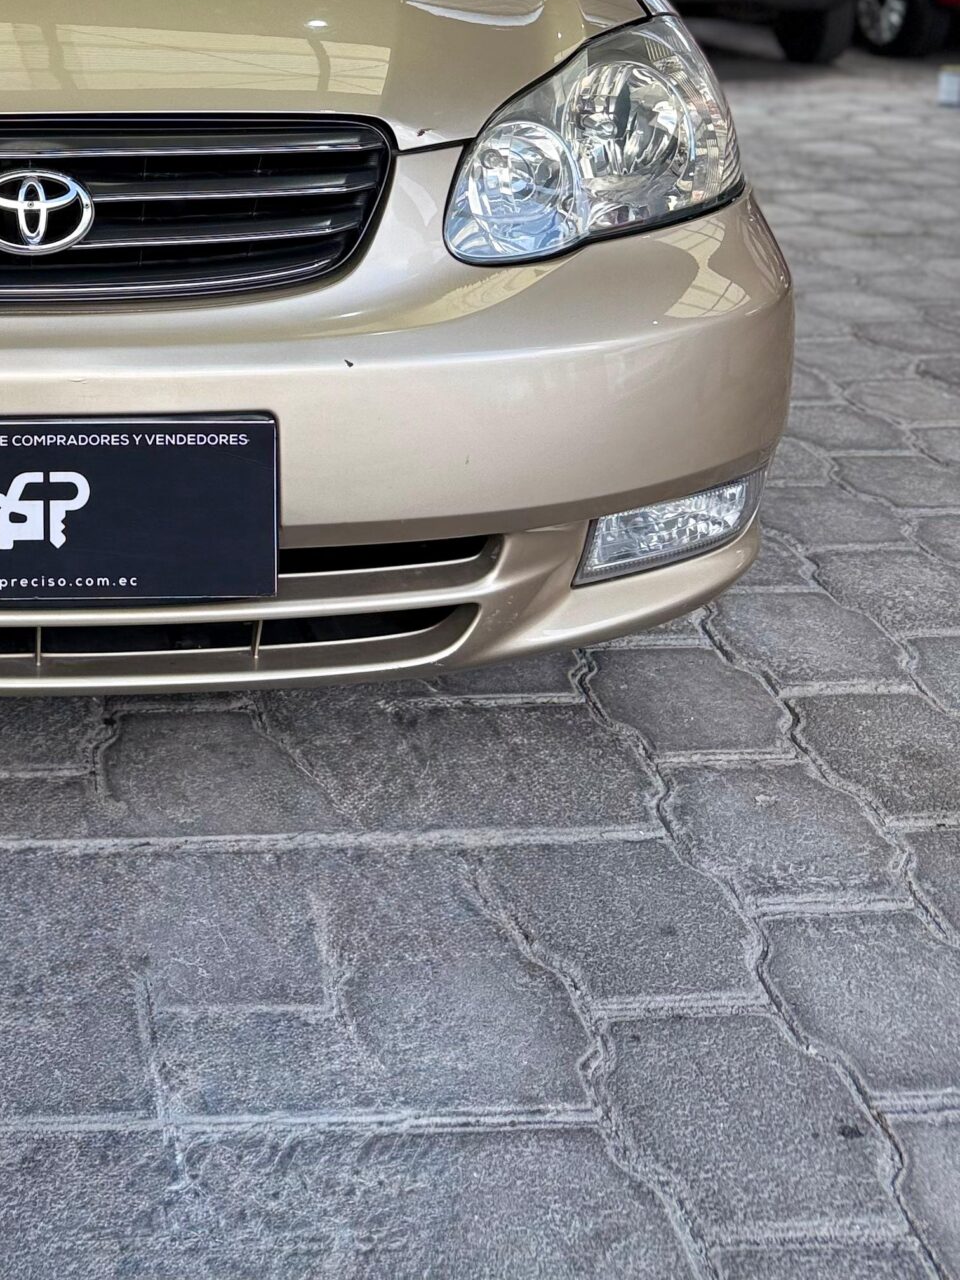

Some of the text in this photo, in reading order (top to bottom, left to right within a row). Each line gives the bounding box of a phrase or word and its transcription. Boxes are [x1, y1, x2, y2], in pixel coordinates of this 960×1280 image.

[11, 434, 130, 447] COMPRADORES
[133, 434, 142, 446] Y
[144, 433, 249, 446] VENDEDORES
